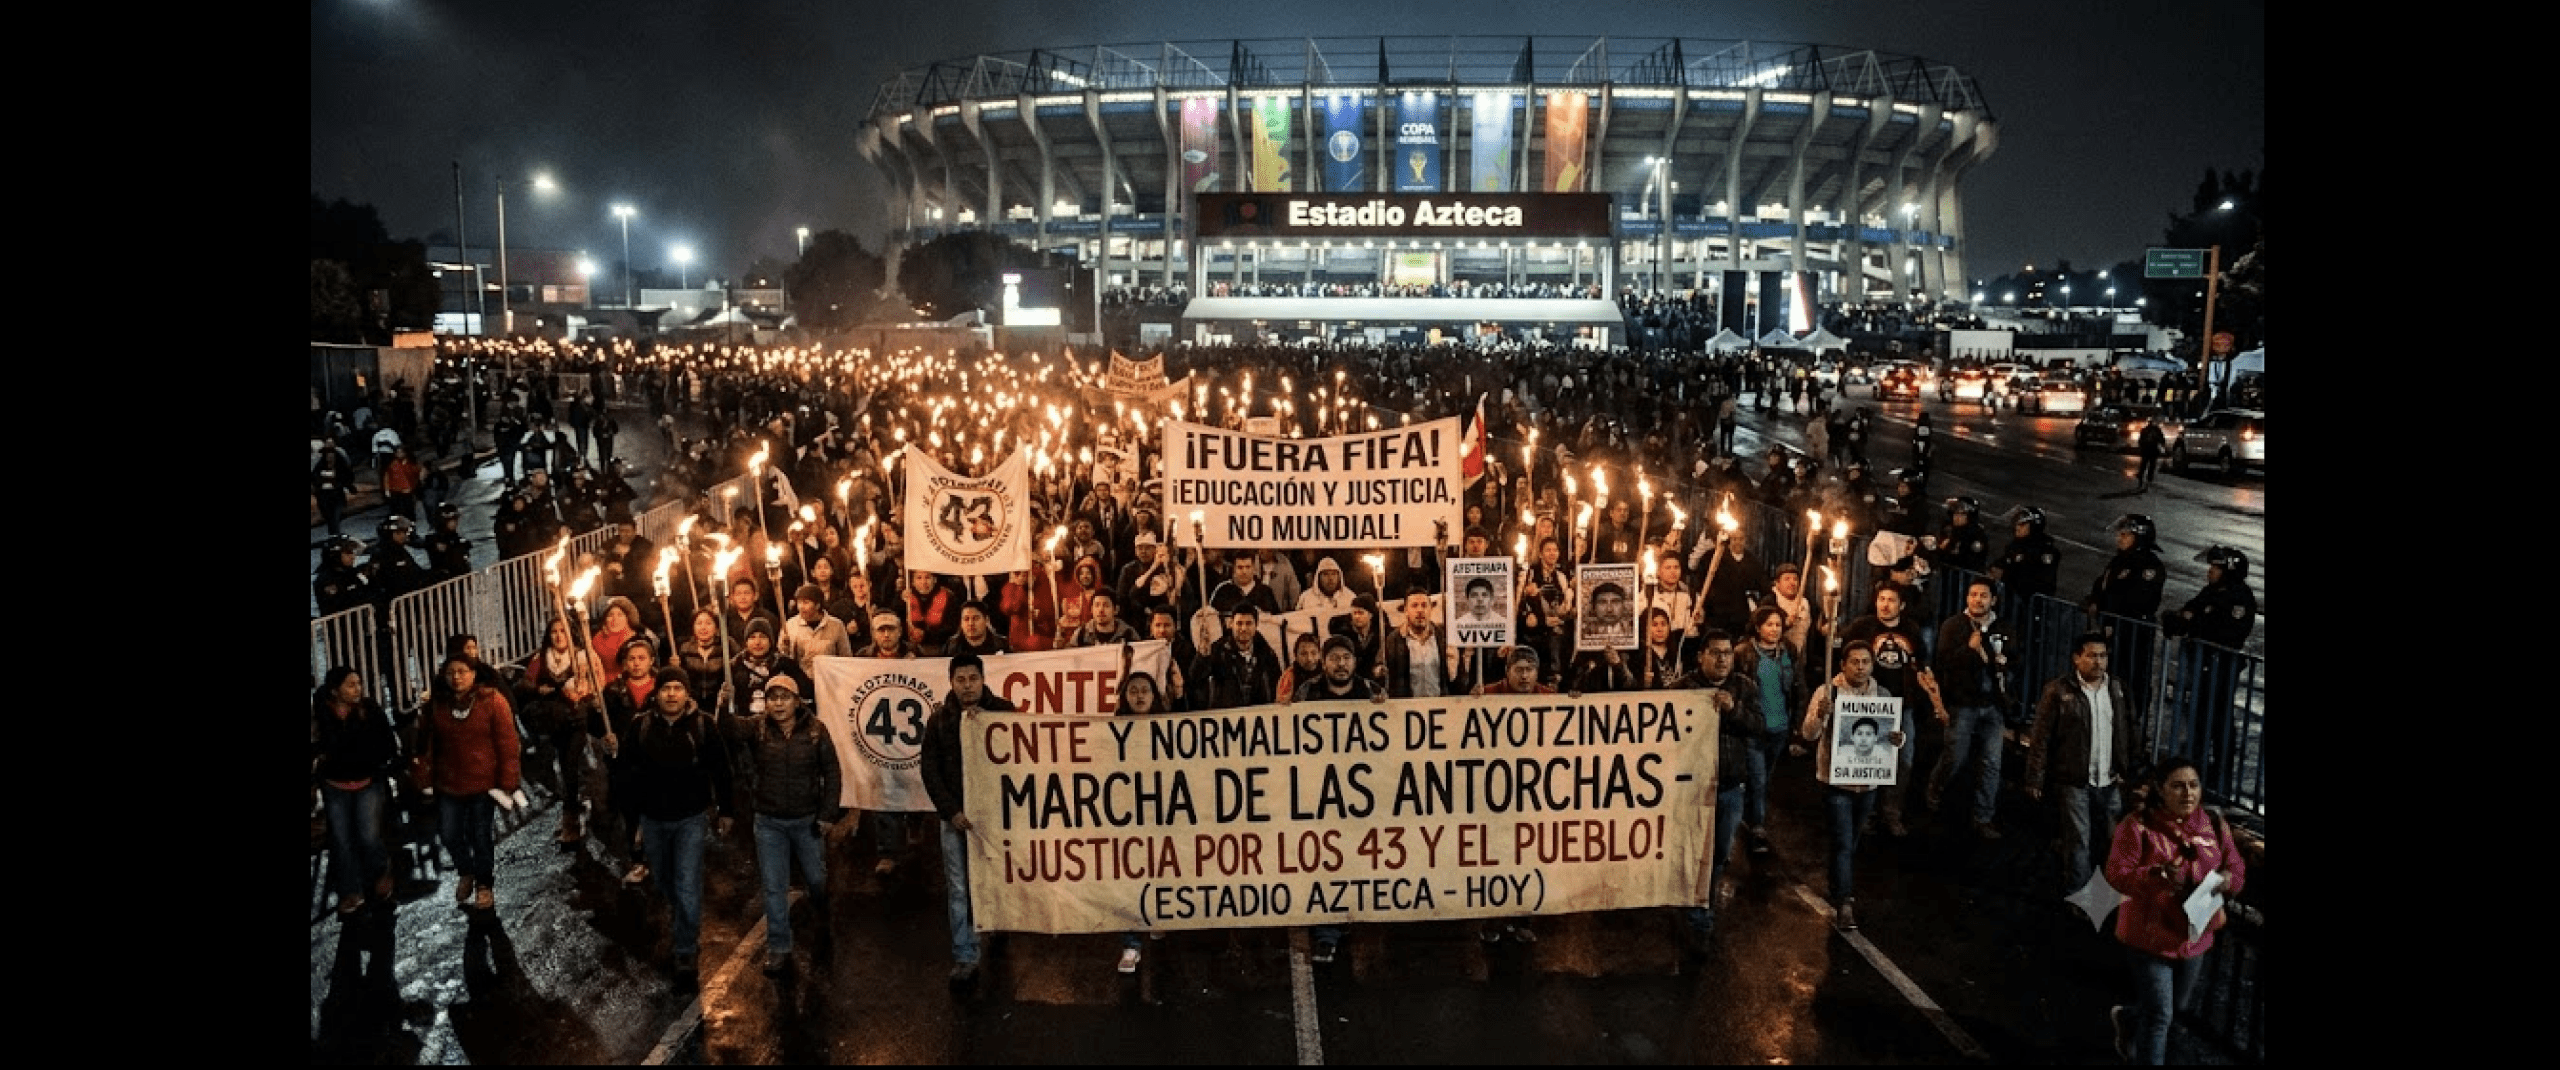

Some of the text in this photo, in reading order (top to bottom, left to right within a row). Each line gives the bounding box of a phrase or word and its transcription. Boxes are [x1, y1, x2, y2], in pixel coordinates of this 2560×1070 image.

[1401, 122, 1435, 136] COPA
[1288, 200, 1523, 227] Estadio Azteca
[1186, 429, 1439, 472] ¡FUERA FIFA!
[1172, 476, 1456, 506] ¡EDUCACIÓN Y JUSTICIA,
[938, 494, 995, 542] 43
[1228, 513, 1401, 541] NO MUNDIAL!
[1457, 630, 1506, 643] VIVE
[1002, 670, 1118, 714] CNTE
[865, 697, 925, 746] 43
[985, 702, 1694, 765] CNTE Y NORMALISTAS DE AYOTZINAPA:
[1001, 769, 1197, 830] MARCHA
[1214, 767, 1271, 824] DE
[1290, 763, 1374, 822] LAS
[1393, 752, 1664, 817] ANTORCHAS
[1003, 814, 1665, 884] ¡JUSTICIA POR LOS 43 Y EL PUEBLO!
[1140, 882, 1291, 927] (ESTADIO
[1306, 877, 1435, 914] AZTECA
[1466, 868, 1545, 912] HOY)
